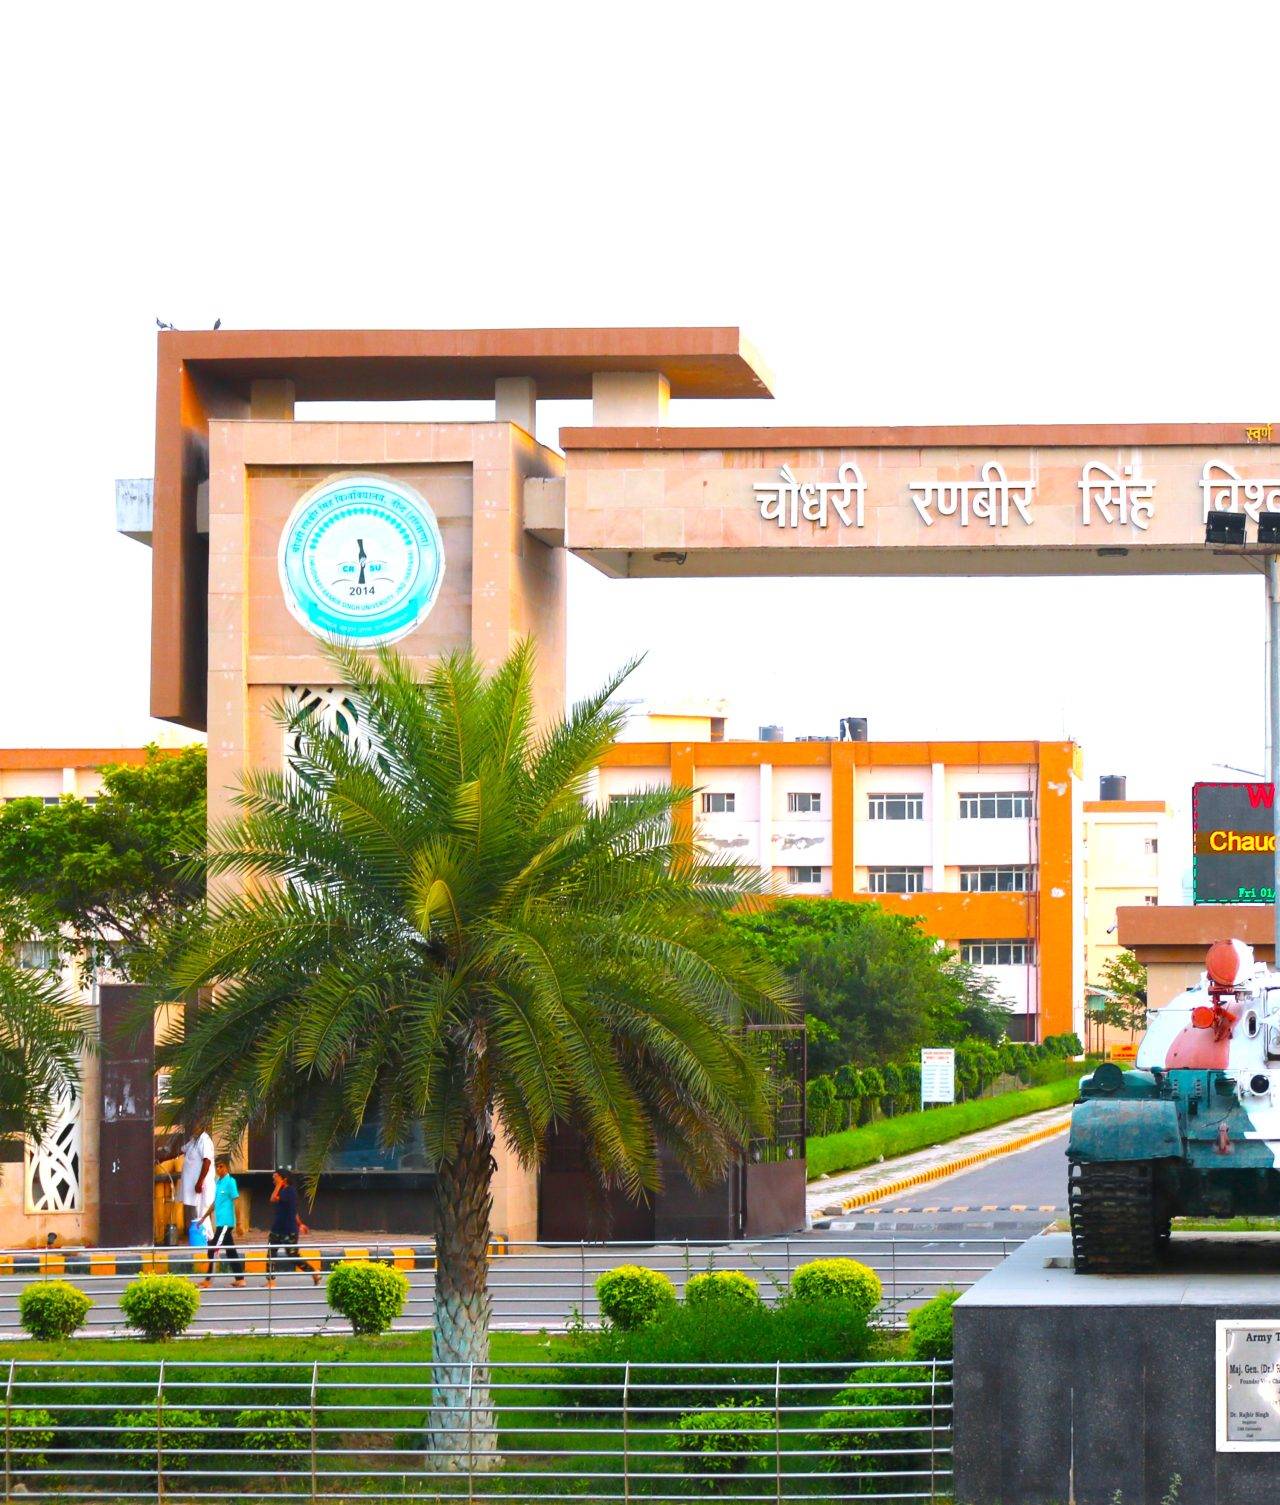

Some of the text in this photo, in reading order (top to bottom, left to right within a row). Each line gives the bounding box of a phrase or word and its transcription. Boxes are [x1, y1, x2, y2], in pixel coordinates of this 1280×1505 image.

[753, 462, 868, 528] चौधरी
[909, 461, 1036, 527] रणबीर
[1077, 460, 1157, 531] सिंह
[349, 586, 376, 596] 2014
[1239, 887, 1257, 898] Fri
[1246, 1332, 1272, 1343] Army
[1229, 1364, 1242, 1375] Maj.
[1245, 1364, 1258, 1374] Gen.
